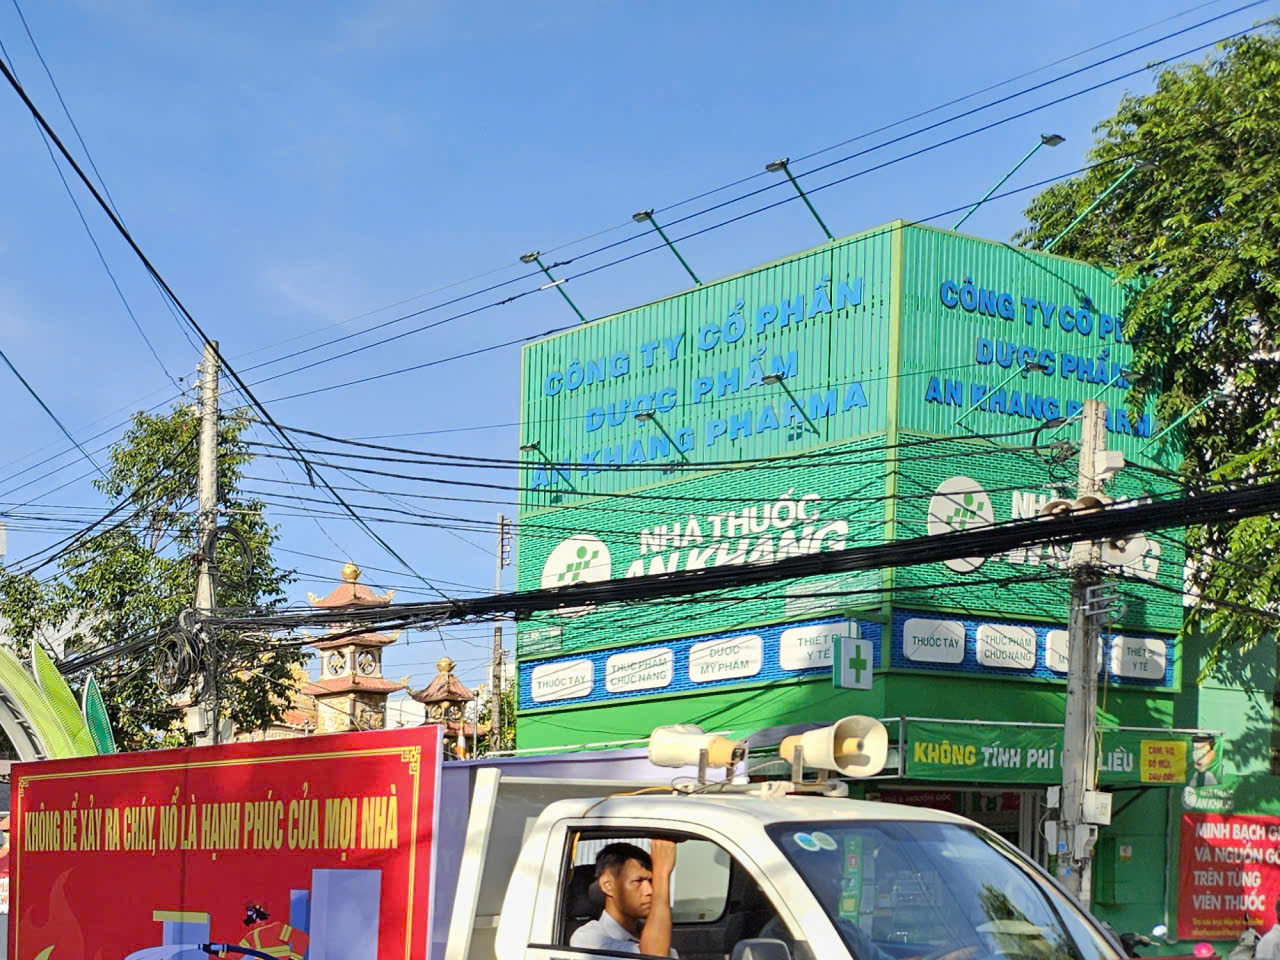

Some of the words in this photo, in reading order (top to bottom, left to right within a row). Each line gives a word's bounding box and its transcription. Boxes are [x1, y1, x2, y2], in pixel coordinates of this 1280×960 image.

[940, 277, 1015, 321] CÔNG
[1021, 297, 1055, 329] TY
[544, 351, 630, 398] CÔNG
[641, 331, 686, 369] TY
[698, 299, 746, 352] CỔ
[756, 274, 863, 334] PHẦN
[693, 345, 798, 404] PHẨM
[925, 376, 963, 407] AN
[971, 383, 1060, 422] KHANG
[580, 427, 696, 478] KHANG
[706, 381, 869, 447] PHARMA
[708, 488, 821, 539] THUỐC
[914, 740, 977, 766] KHÔNG
[981, 741, 1021, 768] TÍNH
[1026, 742, 1057, 769] PHÍ
[24, 802, 61, 852] KHÔNG
[63, 791, 78, 851] ĐỂ
[80, 794, 103, 851] XẢY
[104, 808, 120, 851] RA
[123, 796, 156, 856] CHÁY,
[160, 786, 179, 851] NỔ
[182, 794, 197, 850] LÀ
[202, 802, 240, 861] HẠNH
[244, 789, 284, 850] PHÚC
[288, 782, 319, 850] CỦA
[325, 797, 357, 861] MỌI
[361, 784, 398, 849] NHÀ
[1195, 822, 1230, 839] MINH
[1232, 823, 1266, 844] BẠCH
[1194, 842, 1211, 862] VÀ
[1215, 841, 1263, 863] NGUỒN
[1193, 890, 1221, 910] VIÊN
[1224, 888, 1266, 911] THUỐC
[1194, 867, 1223, 886] TRÊN
